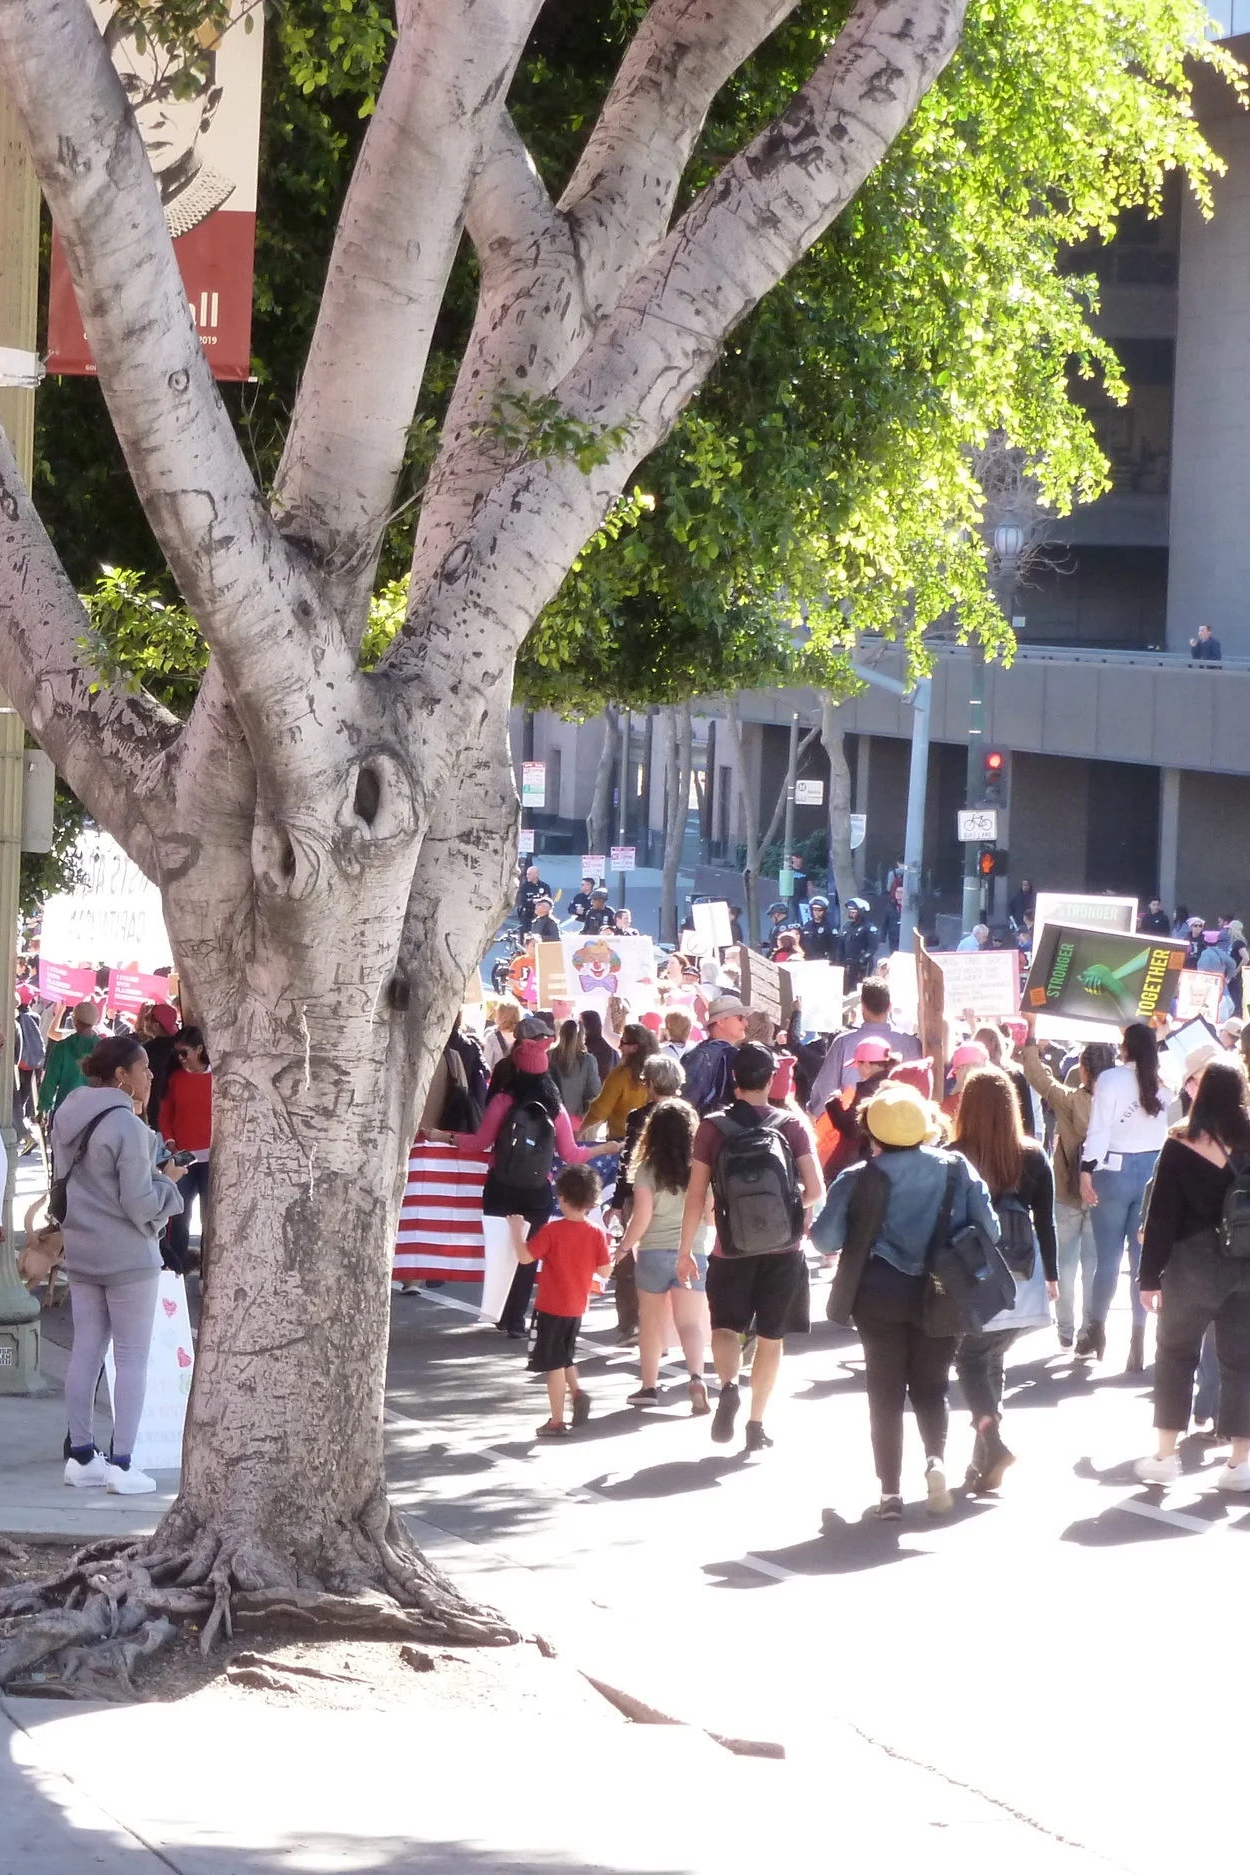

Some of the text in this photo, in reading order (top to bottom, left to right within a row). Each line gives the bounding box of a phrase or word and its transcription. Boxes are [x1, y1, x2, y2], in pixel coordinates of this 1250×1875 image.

[1057, 903, 1119, 920] STRONGER
[1046, 943, 1075, 998] STRONGER
[1135, 948, 1171, 1017] TOGETHER
